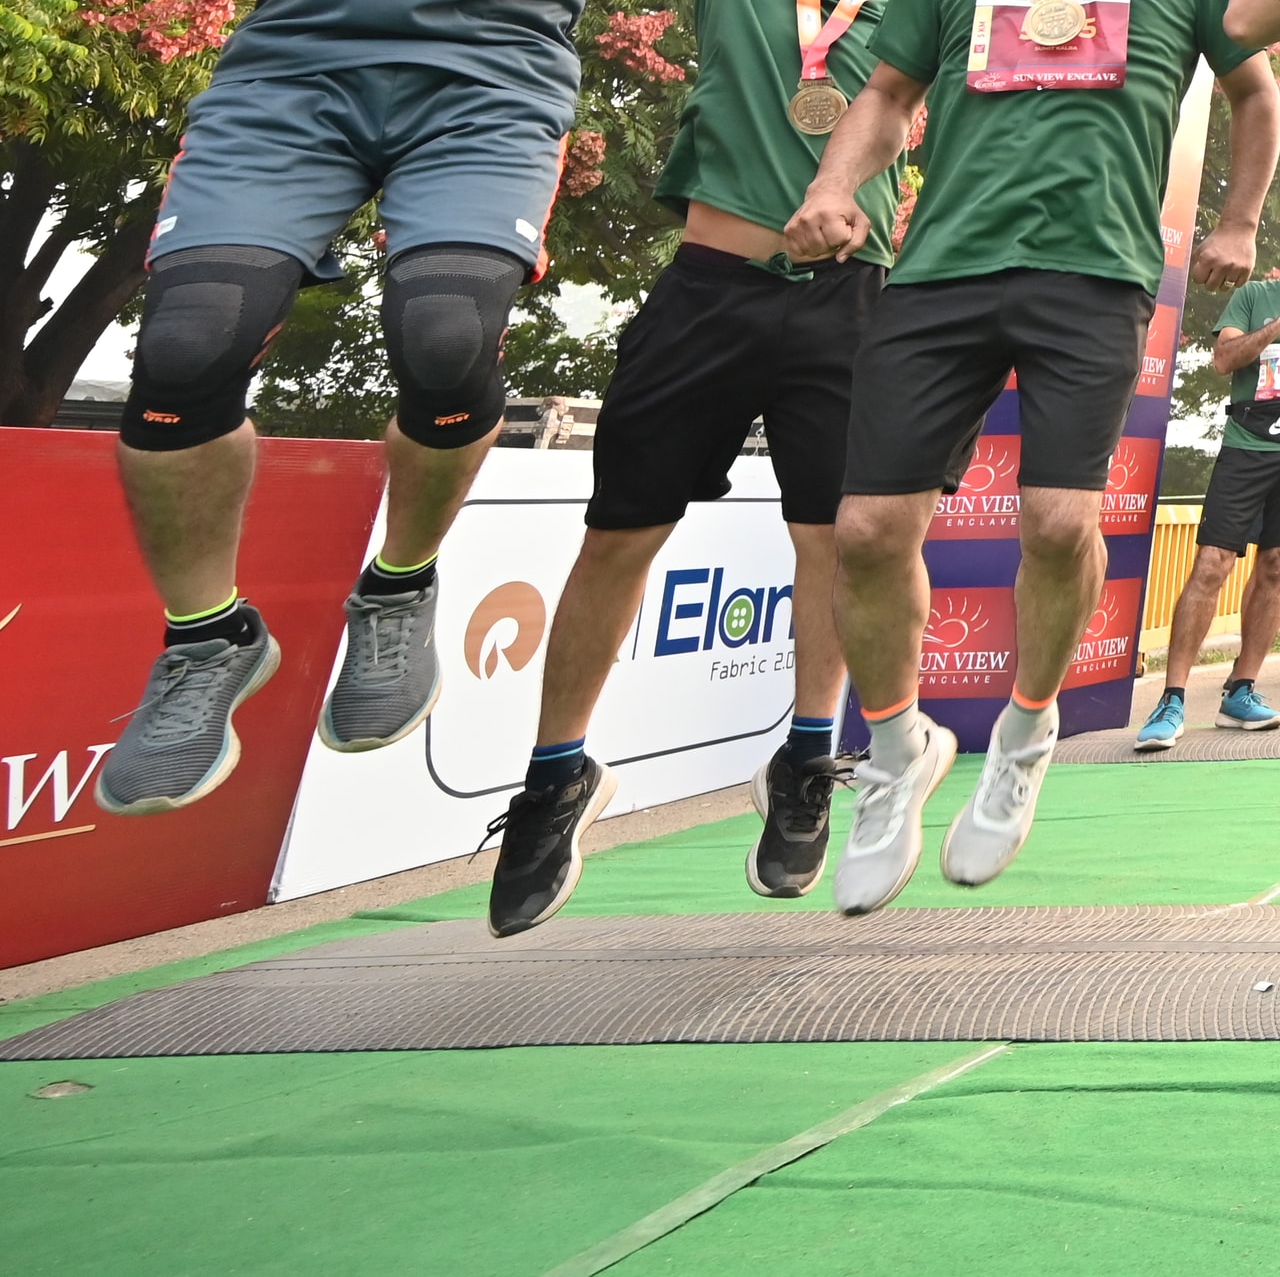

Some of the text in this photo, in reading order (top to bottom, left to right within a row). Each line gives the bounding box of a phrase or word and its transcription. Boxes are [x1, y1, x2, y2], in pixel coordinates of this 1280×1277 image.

[1013, 72, 1117, 83] SUN VIEW ENCLAVE
[935, 495, 975, 514] SUN
[1100, 493, 1148, 510] UN VIEW
[947, 517, 1017, 527] ENCLAVE
[654, 567, 794, 657] Elan
[1097, 636, 1128, 656] VIEW
[710, 651, 795, 681] Fabric 2.0
[919, 651, 1010, 671] UN VIEW
[1076, 659, 1118, 674] ENCLAVE
